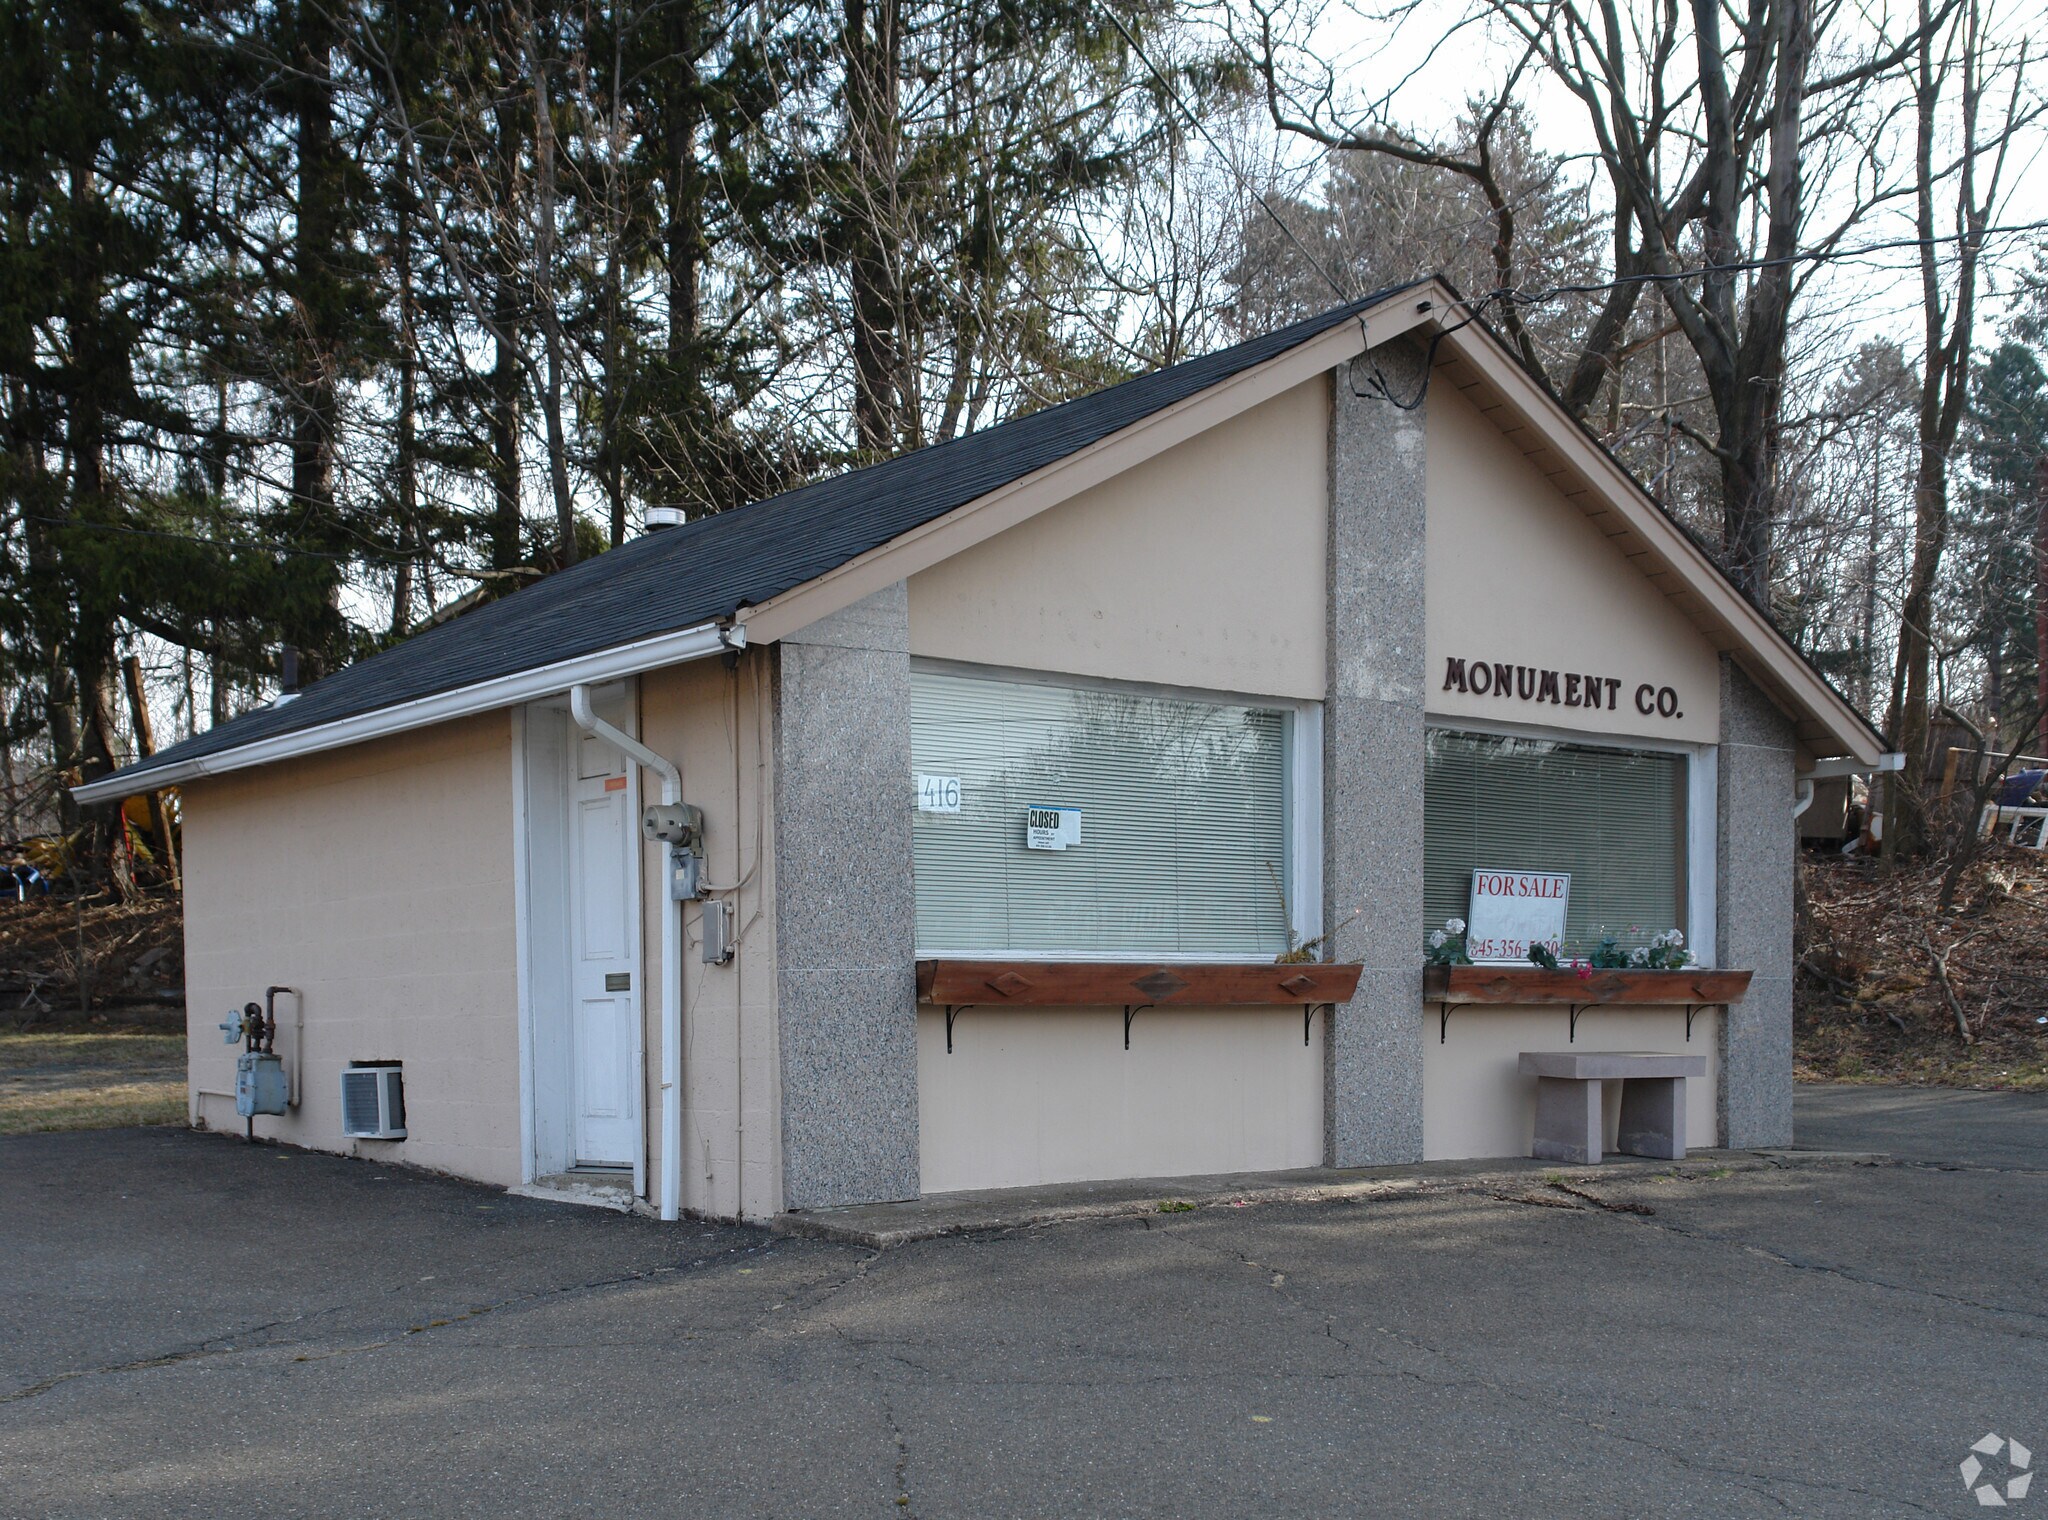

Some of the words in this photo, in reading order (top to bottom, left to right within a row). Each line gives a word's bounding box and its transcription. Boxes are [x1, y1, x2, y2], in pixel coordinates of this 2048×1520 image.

[1443, 657, 1621, 710] MONUMENT
[1635, 684, 1683, 718] CO.
[924, 778, 958, 808] 416
[1030, 809, 1059, 829] CLOSED
[1477, 875, 1515, 896] FOR
[1519, 877, 1564, 898] SALE
